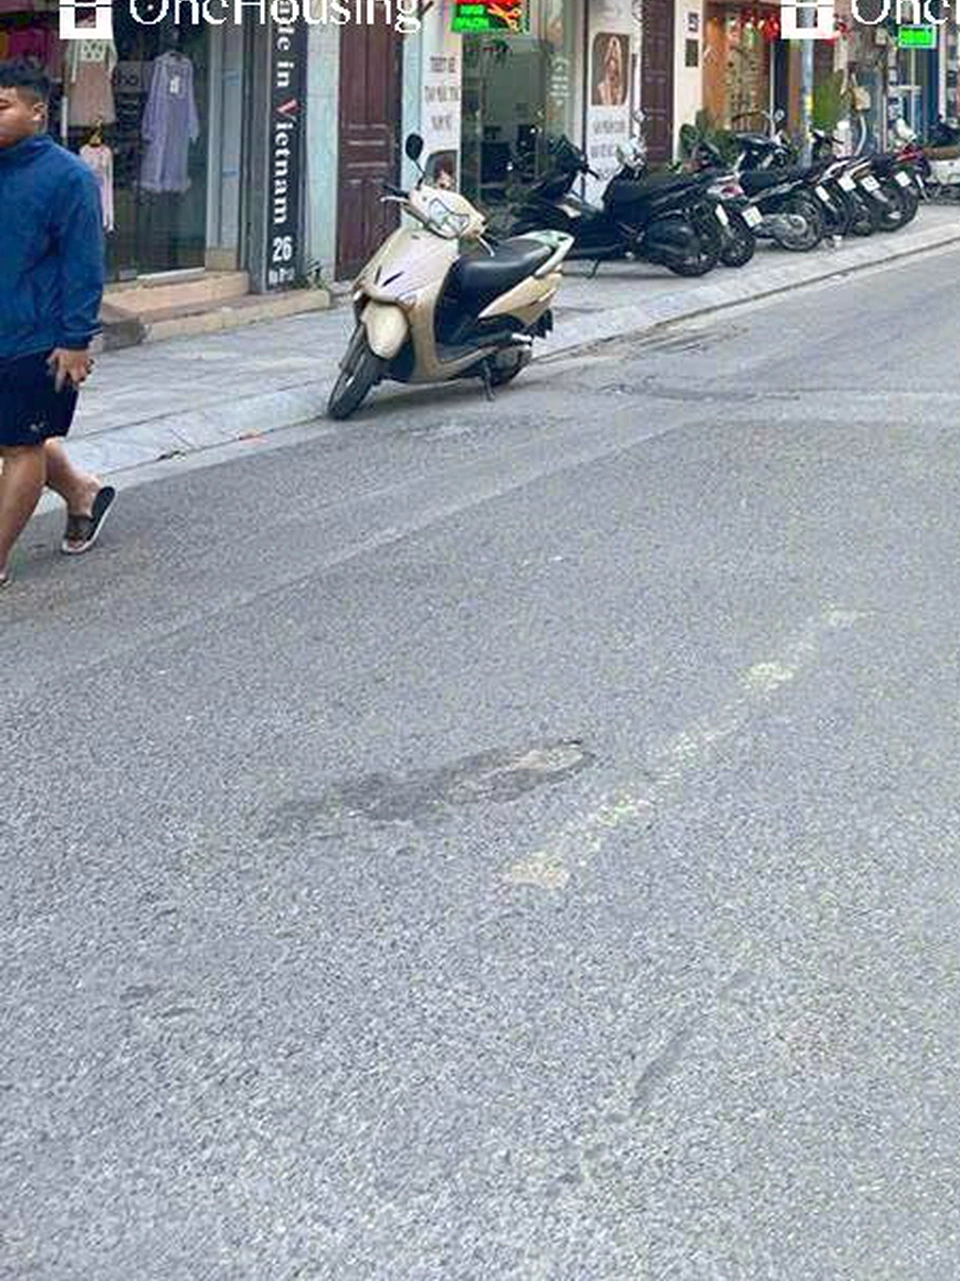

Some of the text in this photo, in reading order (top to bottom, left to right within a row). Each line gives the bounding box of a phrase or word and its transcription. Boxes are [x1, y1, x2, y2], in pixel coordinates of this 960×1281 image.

[277, 61, 295, 88] in
[273, 97, 299, 225] Vietnam
[272, 235, 293, 262] 26
